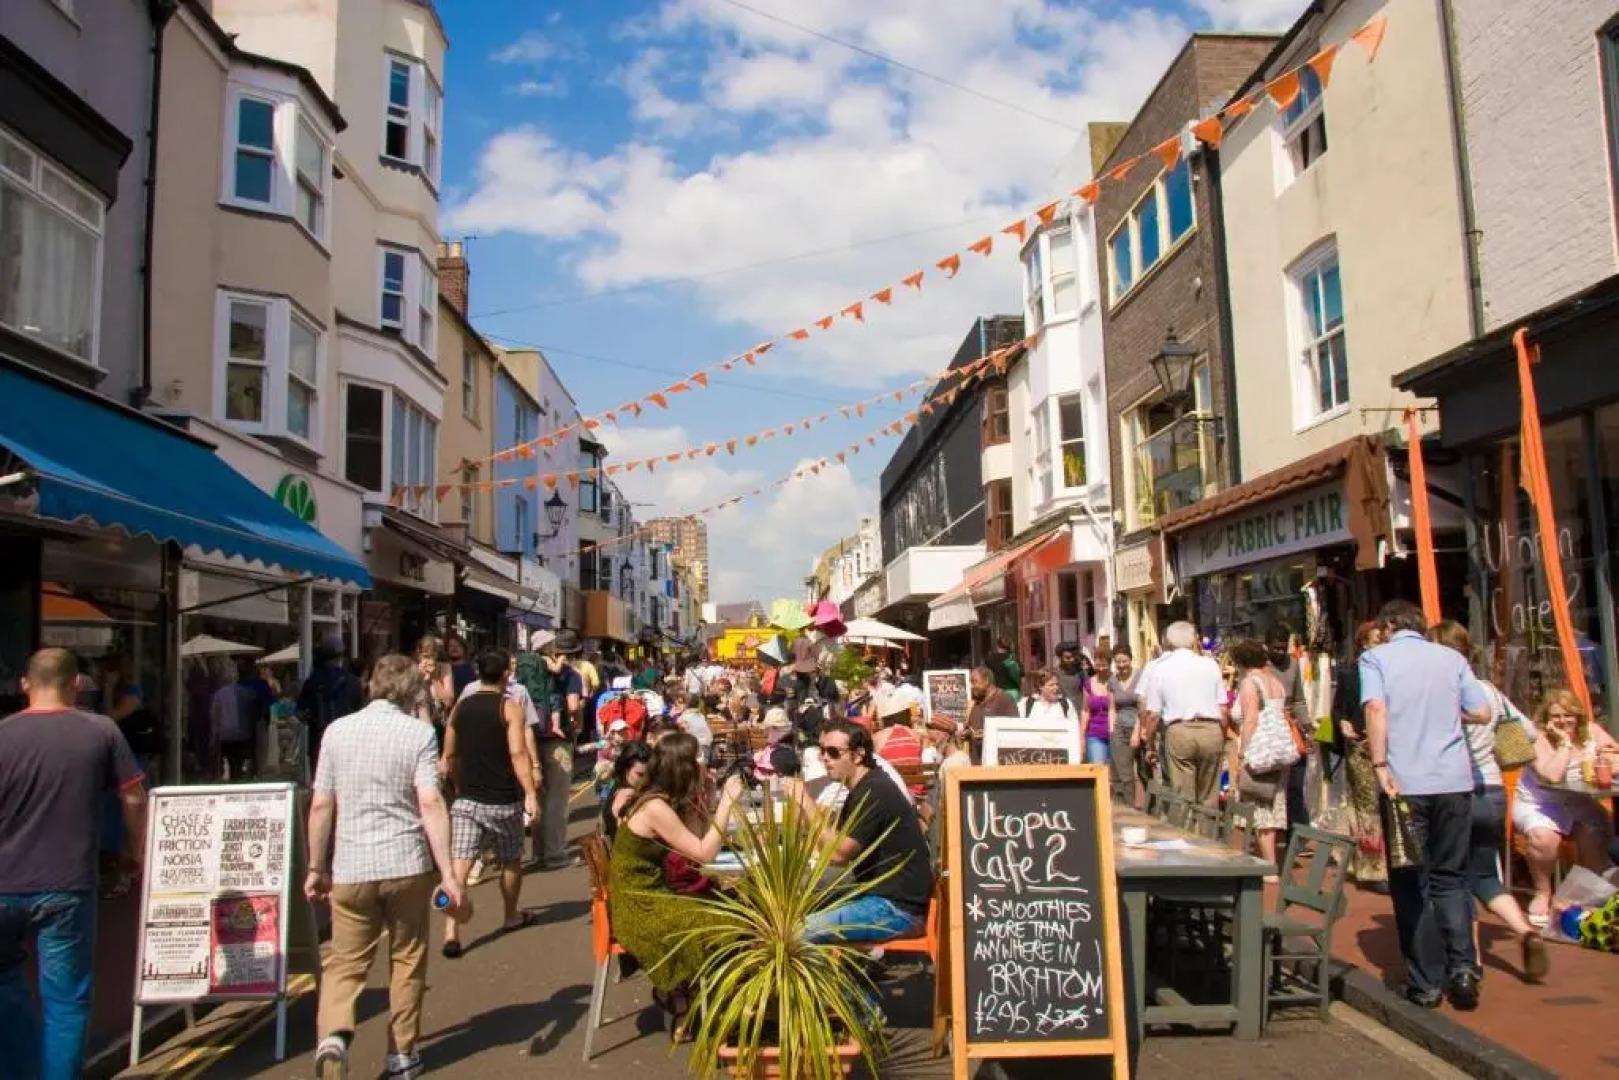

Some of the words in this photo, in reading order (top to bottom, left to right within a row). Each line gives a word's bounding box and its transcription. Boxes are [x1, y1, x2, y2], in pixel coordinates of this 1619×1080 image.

[1226, 509, 1286, 557] FABRIC
[1294, 492, 1343, 541] FAIR
[162, 814, 201, 827] CHASE
[165, 825, 210, 837] STATUS
[967, 791, 1076, 849] Utopia
[159, 839, 212, 851] FRICTION
[163, 853, 203, 866] NOISIA
[970, 839, 1041, 895] Cafe
[1045, 832, 1080, 882] 2
[987, 898, 1092, 922] SMOOTHIES
[1028, 919, 1075, 941] THAN
[973, 938, 1055, 963] ANYWHERE
[1058, 941, 1081, 966] IN
